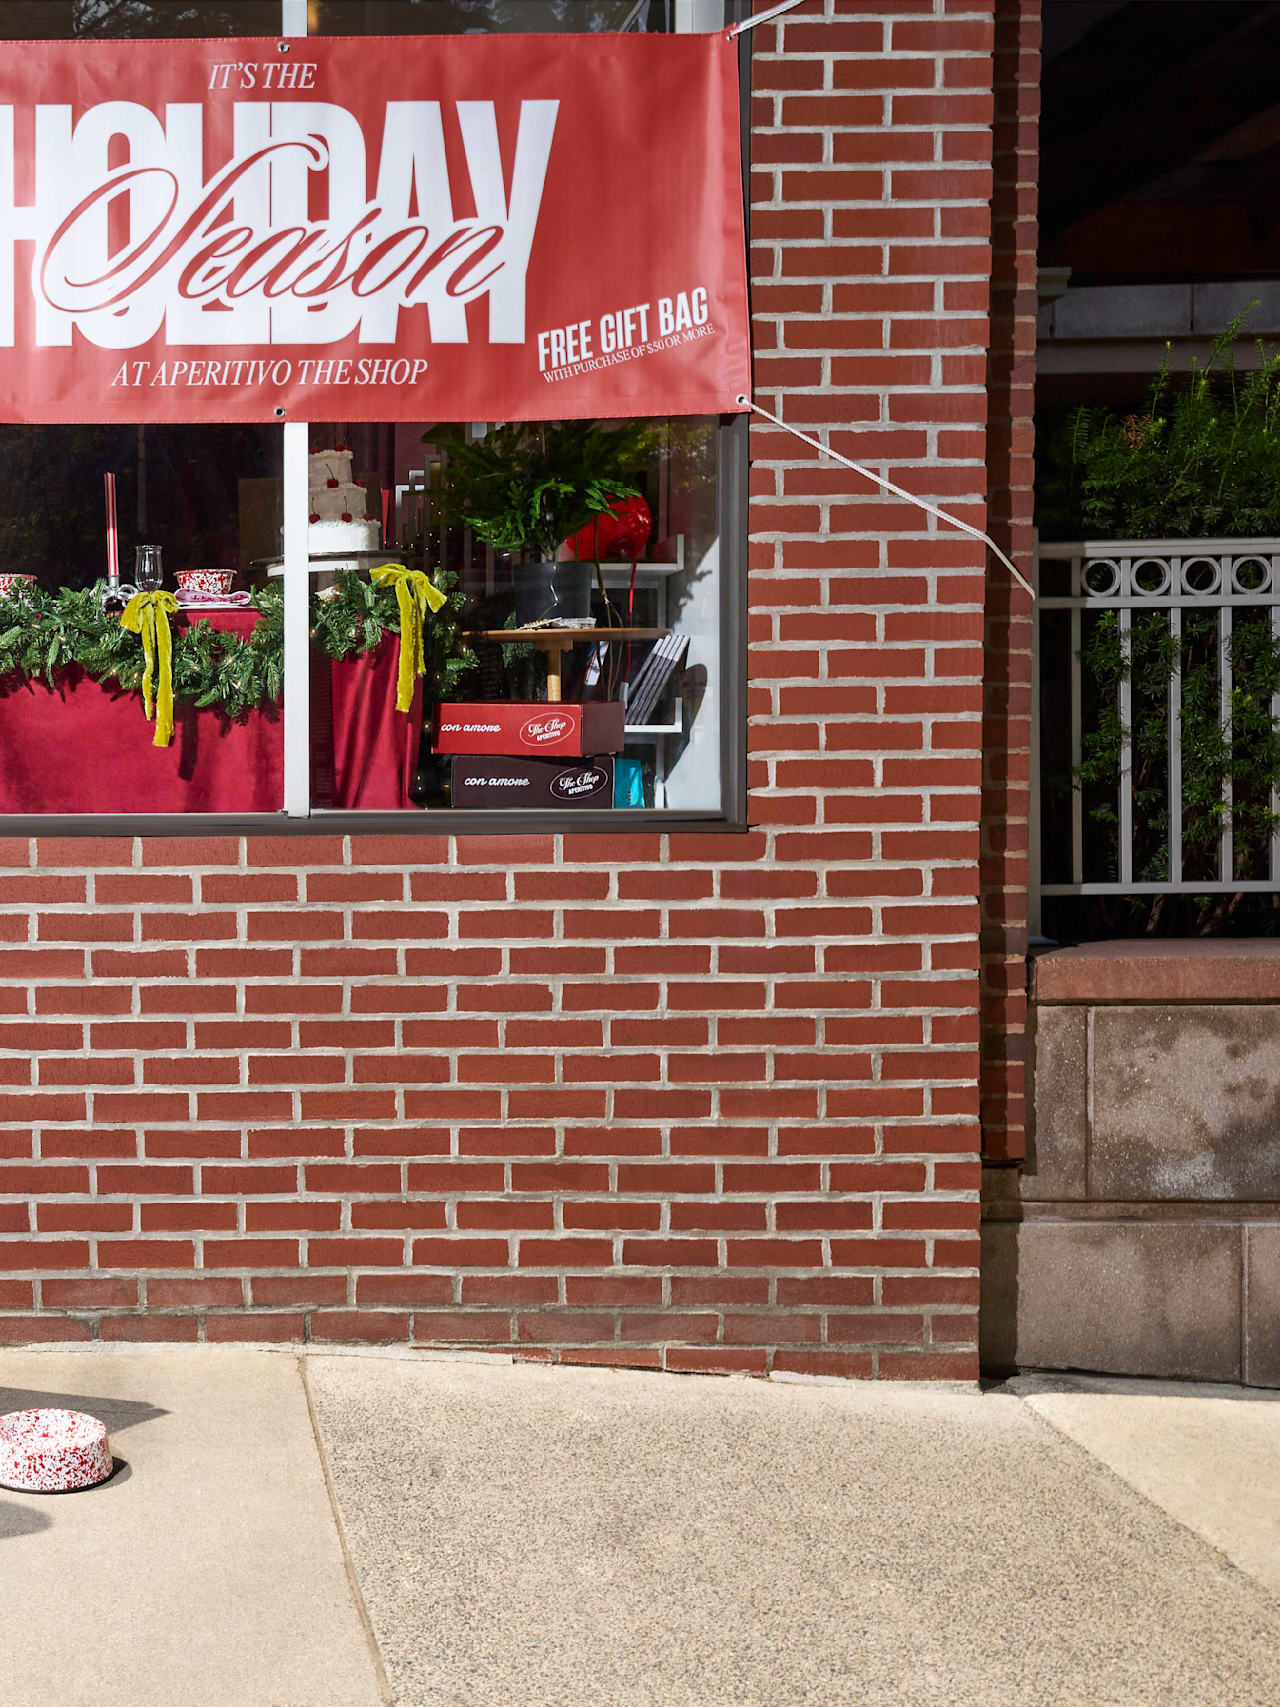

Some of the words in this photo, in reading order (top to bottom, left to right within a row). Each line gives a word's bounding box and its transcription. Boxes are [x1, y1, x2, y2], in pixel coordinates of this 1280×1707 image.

[208, 62, 258, 90] IT’S
[262, 62, 317, 89] THE
[40, 141, 505, 313] Season
[537, 320, 593, 372] FREE
[600, 303, 650, 353] GIFT
[658, 286, 709, 337] BAG
[111, 360, 150, 387] AT
[150, 359, 292, 387] APERITIVO
[297, 359, 353, 385] THE
[354, 357, 428, 386] SHOP
[543, 365, 573, 383] WITH
[573, 349, 631, 376] PURCHASE
[631, 345, 646, 359] OF
[647, 340, 665, 355] $50
[665, 335, 682, 349] OR
[441, 723, 462, 732] con
[463, 723, 501, 732] amore
[527, 723, 544, 737] The
[544, 718, 567, 733] Shop
[464, 776, 487, 786] con
[488, 777, 530, 787] amore
[558, 777, 576, 791] The
[576, 771, 600, 787] Shop
